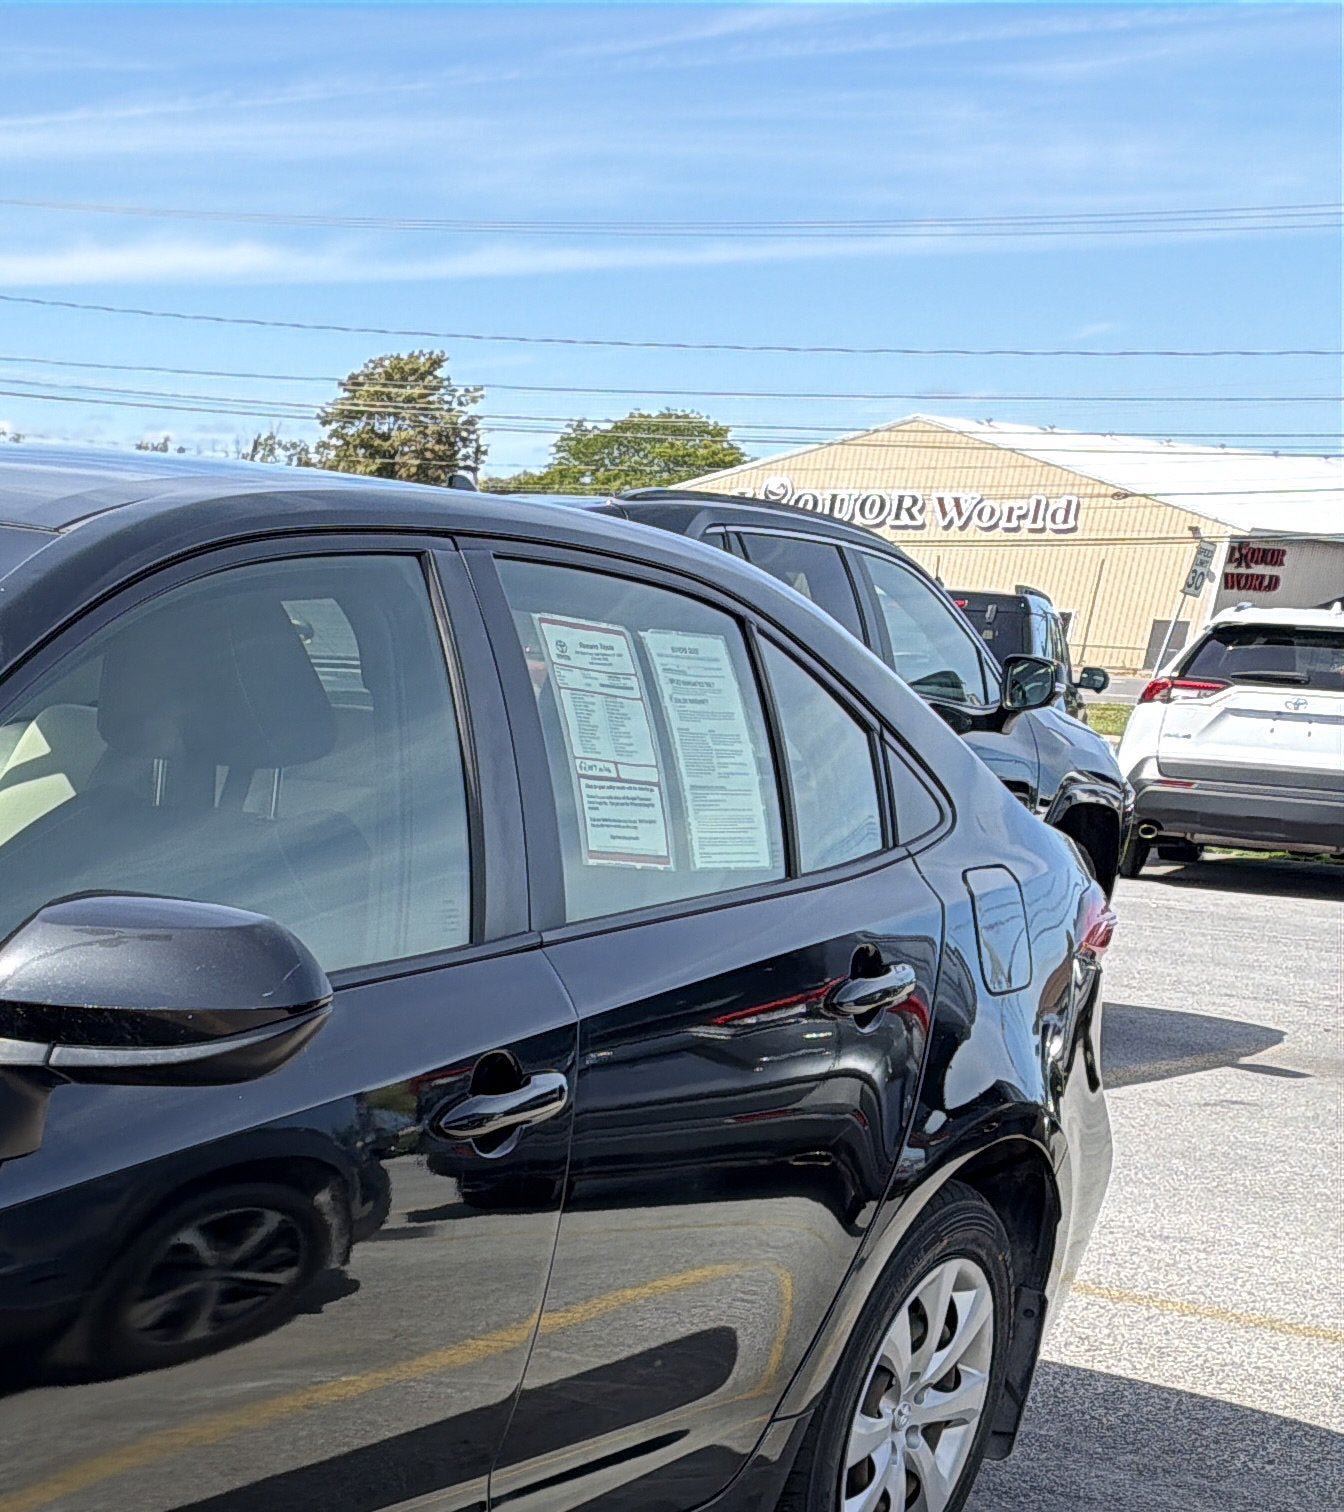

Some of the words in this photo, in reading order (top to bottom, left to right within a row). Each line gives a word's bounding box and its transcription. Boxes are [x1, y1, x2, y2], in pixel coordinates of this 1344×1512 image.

[931, 493, 1081, 535] World
[1187, 569, 1205, 591] 30
[1223, 572, 1281, 592] WORLD
